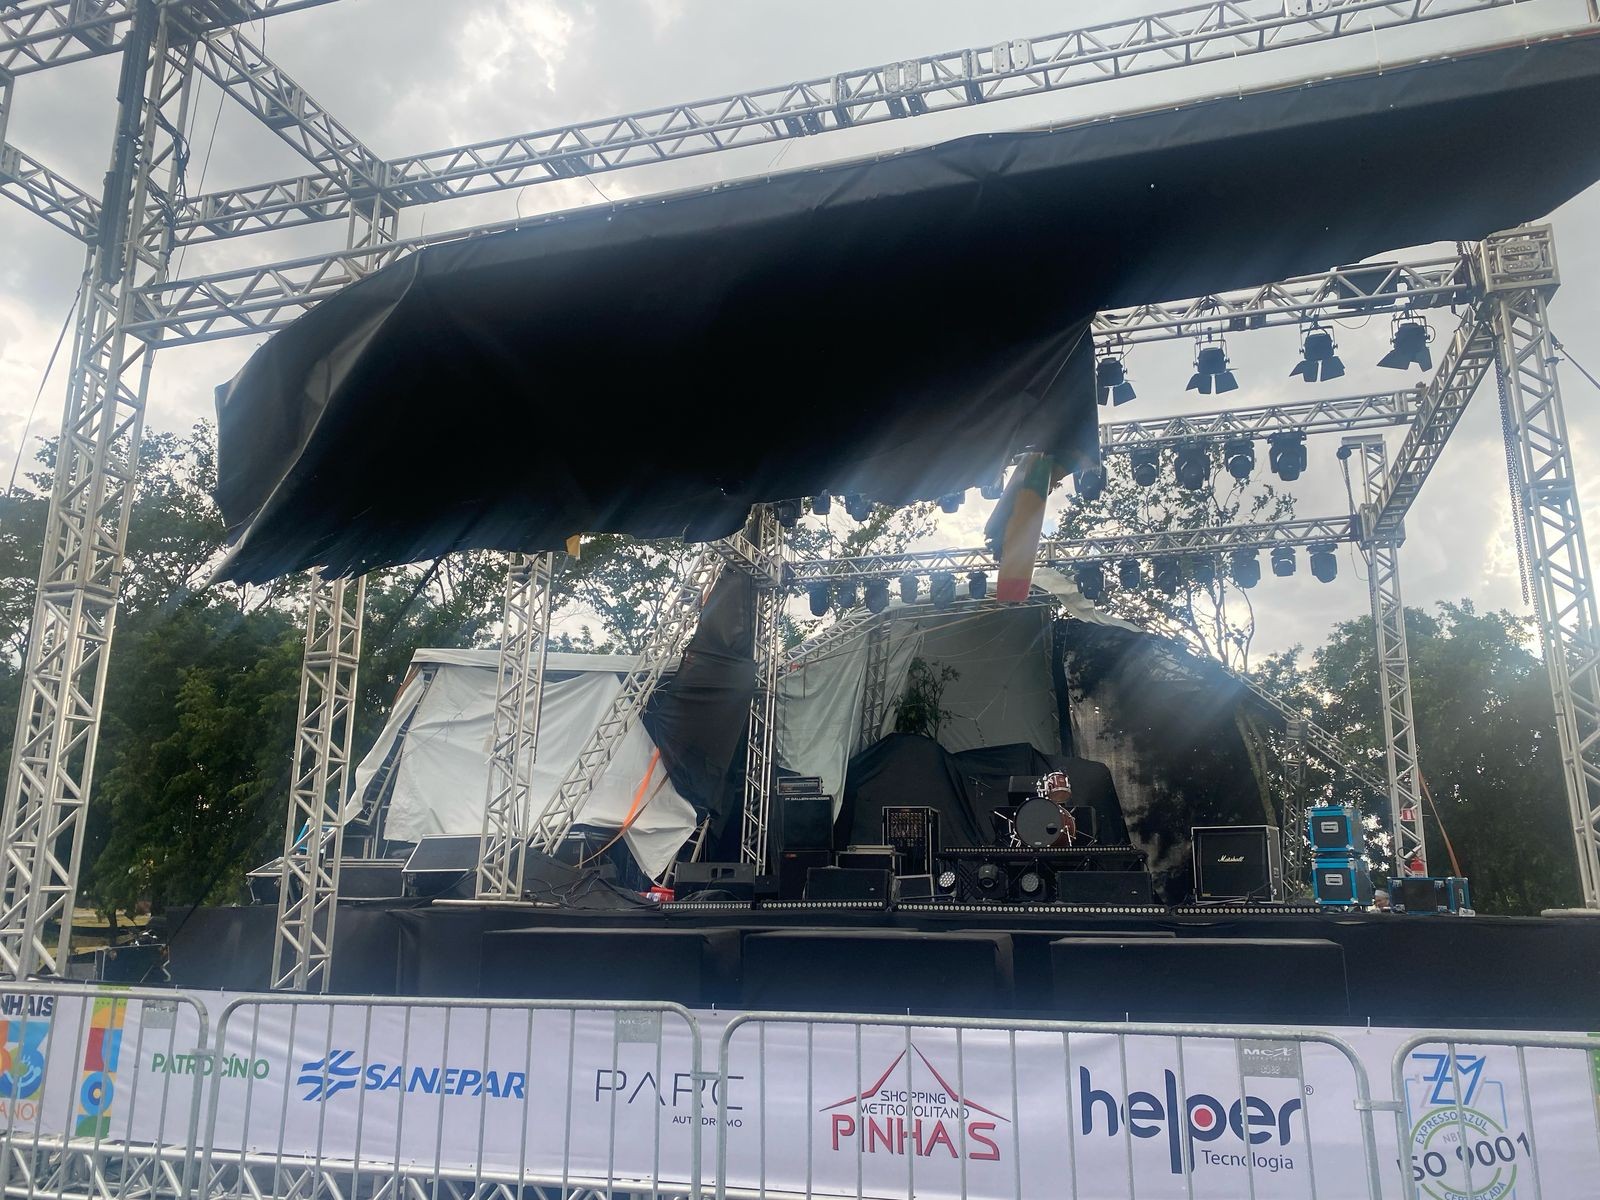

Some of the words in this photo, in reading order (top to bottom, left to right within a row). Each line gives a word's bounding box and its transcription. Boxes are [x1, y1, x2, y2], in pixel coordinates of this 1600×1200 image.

[151, 1053, 270, 1080] PATROCÍNO
[363, 1063, 527, 1100] SANEPAR
[595, 1068, 744, 1111] PARC
[880, 1090, 946, 1105] SHOPPING
[672, 1115, 743, 1129] AUTDRMO
[1079, 1065, 1302, 1175] helper
[1415, 1111, 1458, 1145] EXPRESSO
[1463, 1112, 1488, 1131] AZUL
[832, 1113, 1000, 1161] PINHAS
[1442, 1131, 1461, 1144] NB
[1455, 1131, 1530, 1169] 9001
[1201, 1149, 1294, 1172] Tecnologia
[1444, 1182, 1507, 1200] CERFICADA
